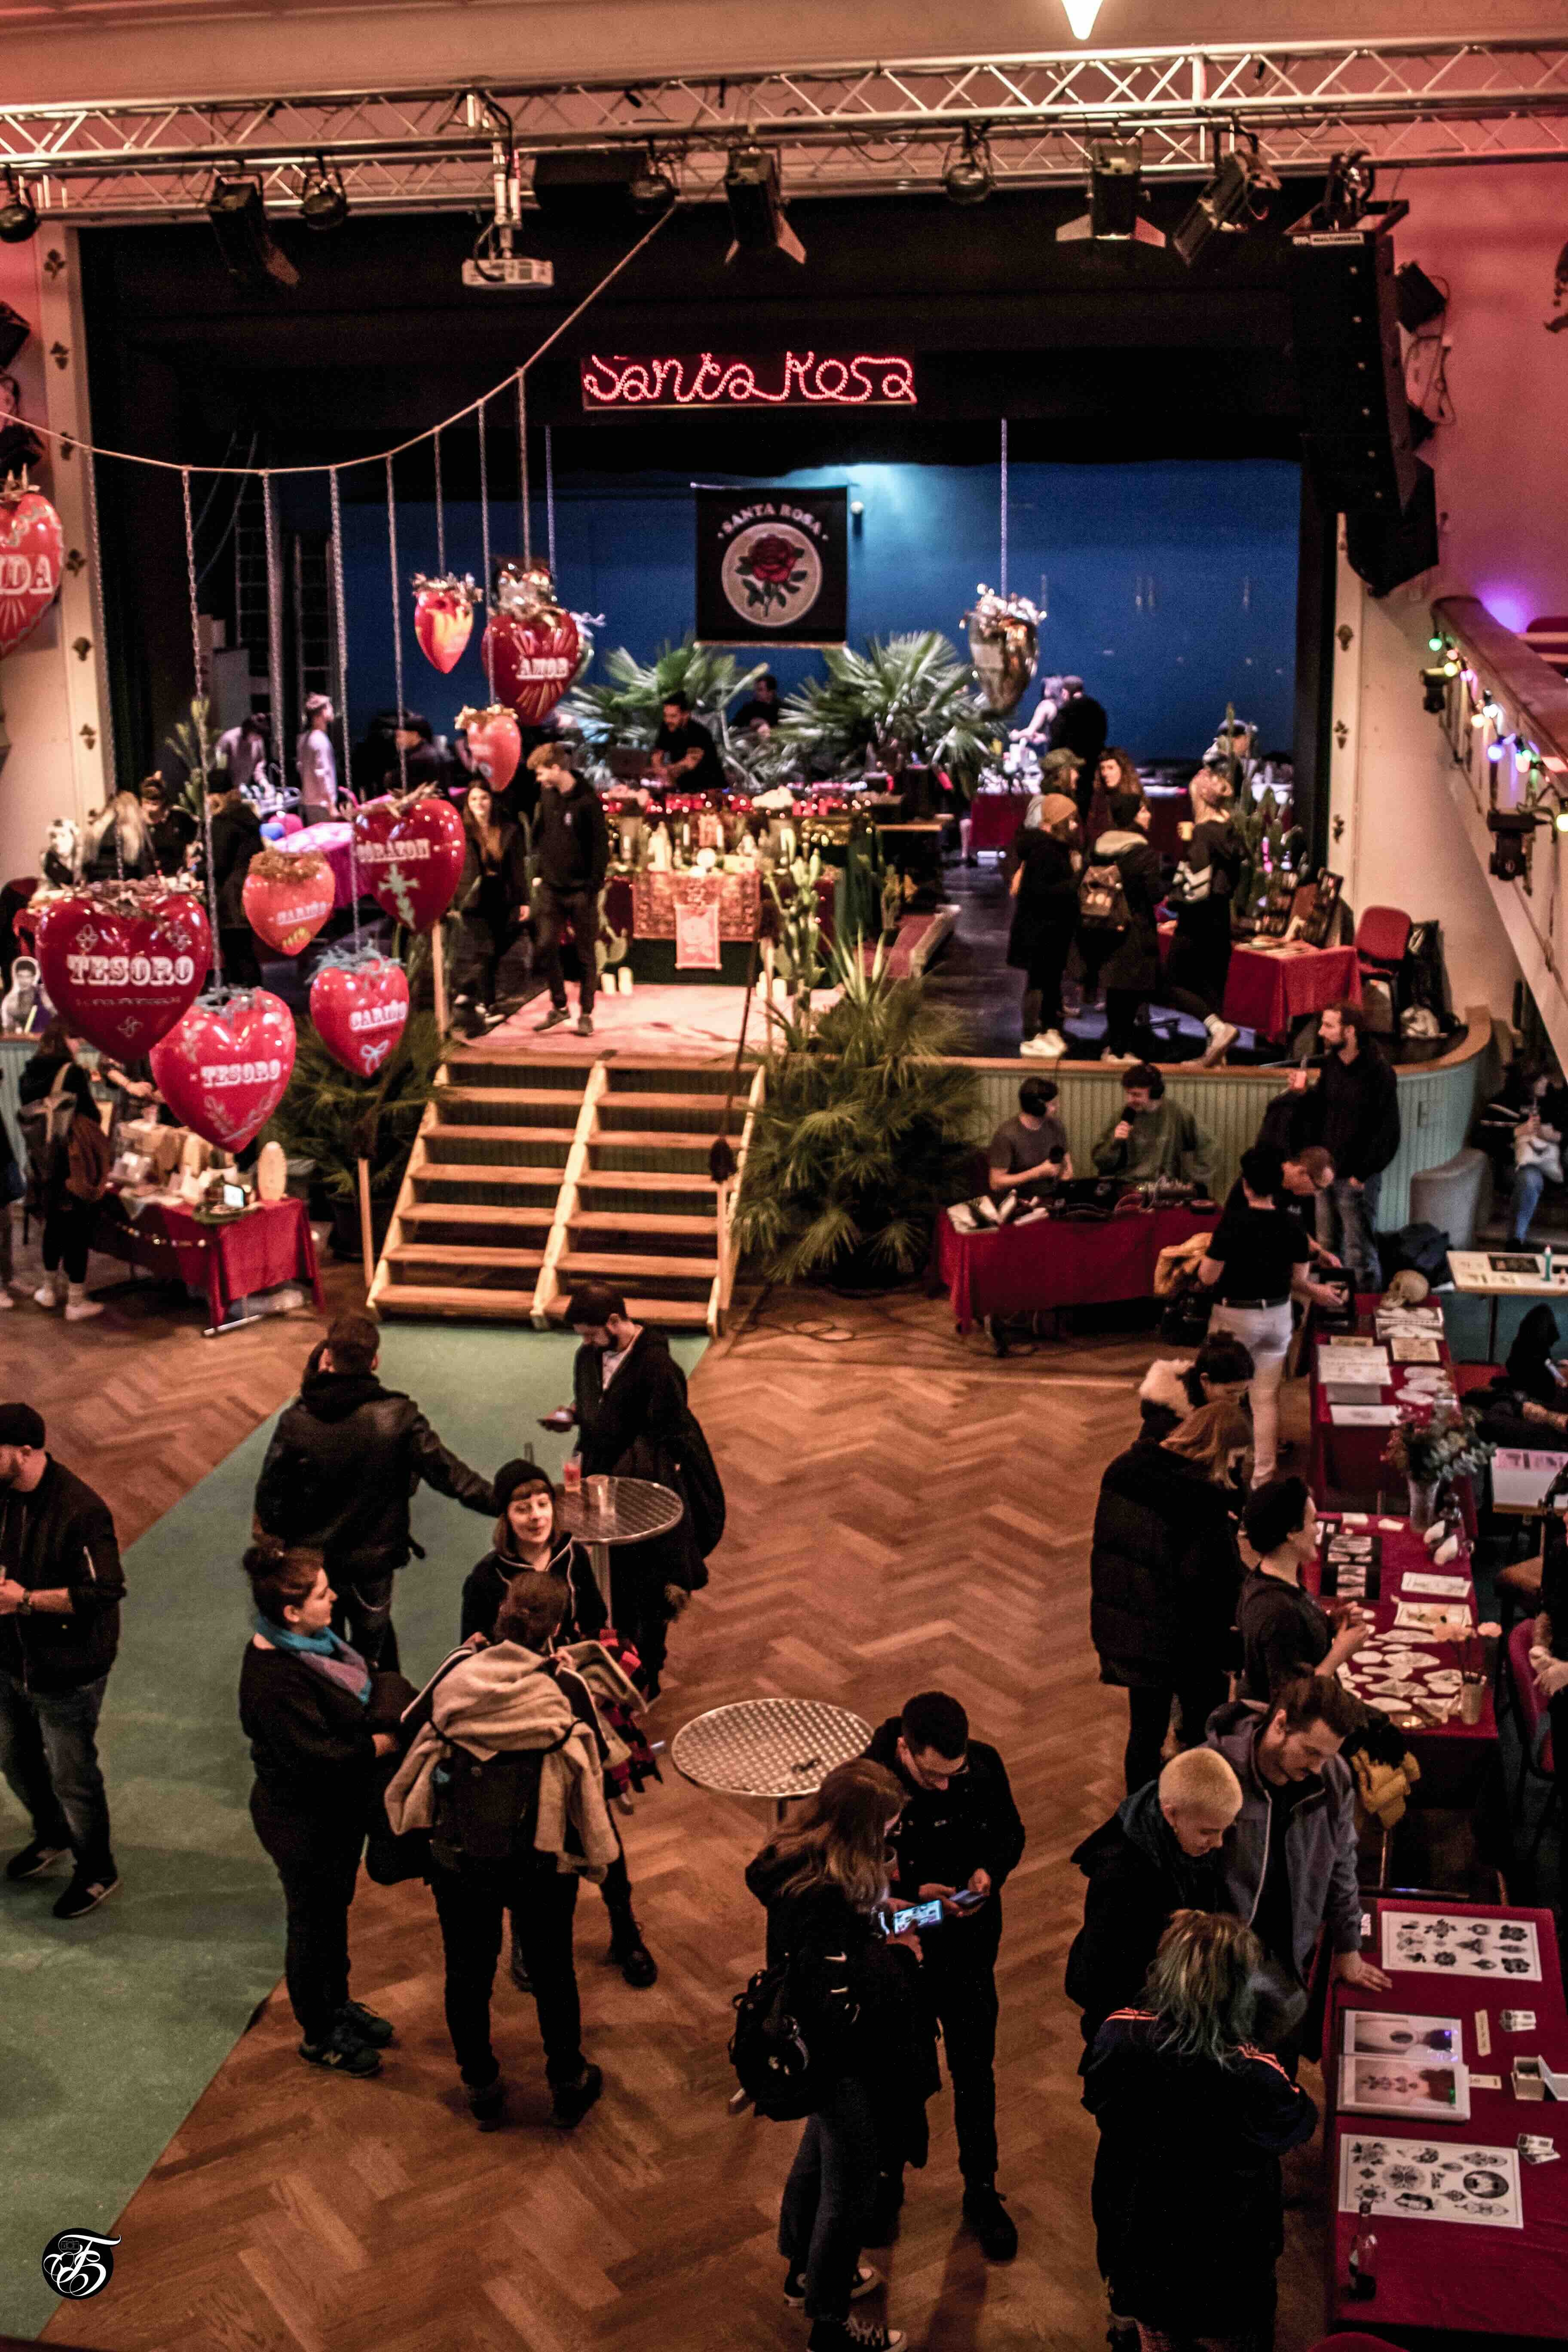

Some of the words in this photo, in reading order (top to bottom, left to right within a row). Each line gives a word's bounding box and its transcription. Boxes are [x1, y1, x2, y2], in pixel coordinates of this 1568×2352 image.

[722, 503, 776, 534] SANTA
[779, 503, 822, 535] ROSA
[66, 954, 195, 986] TESORO
[200, 1060, 282, 1087] TESORO
